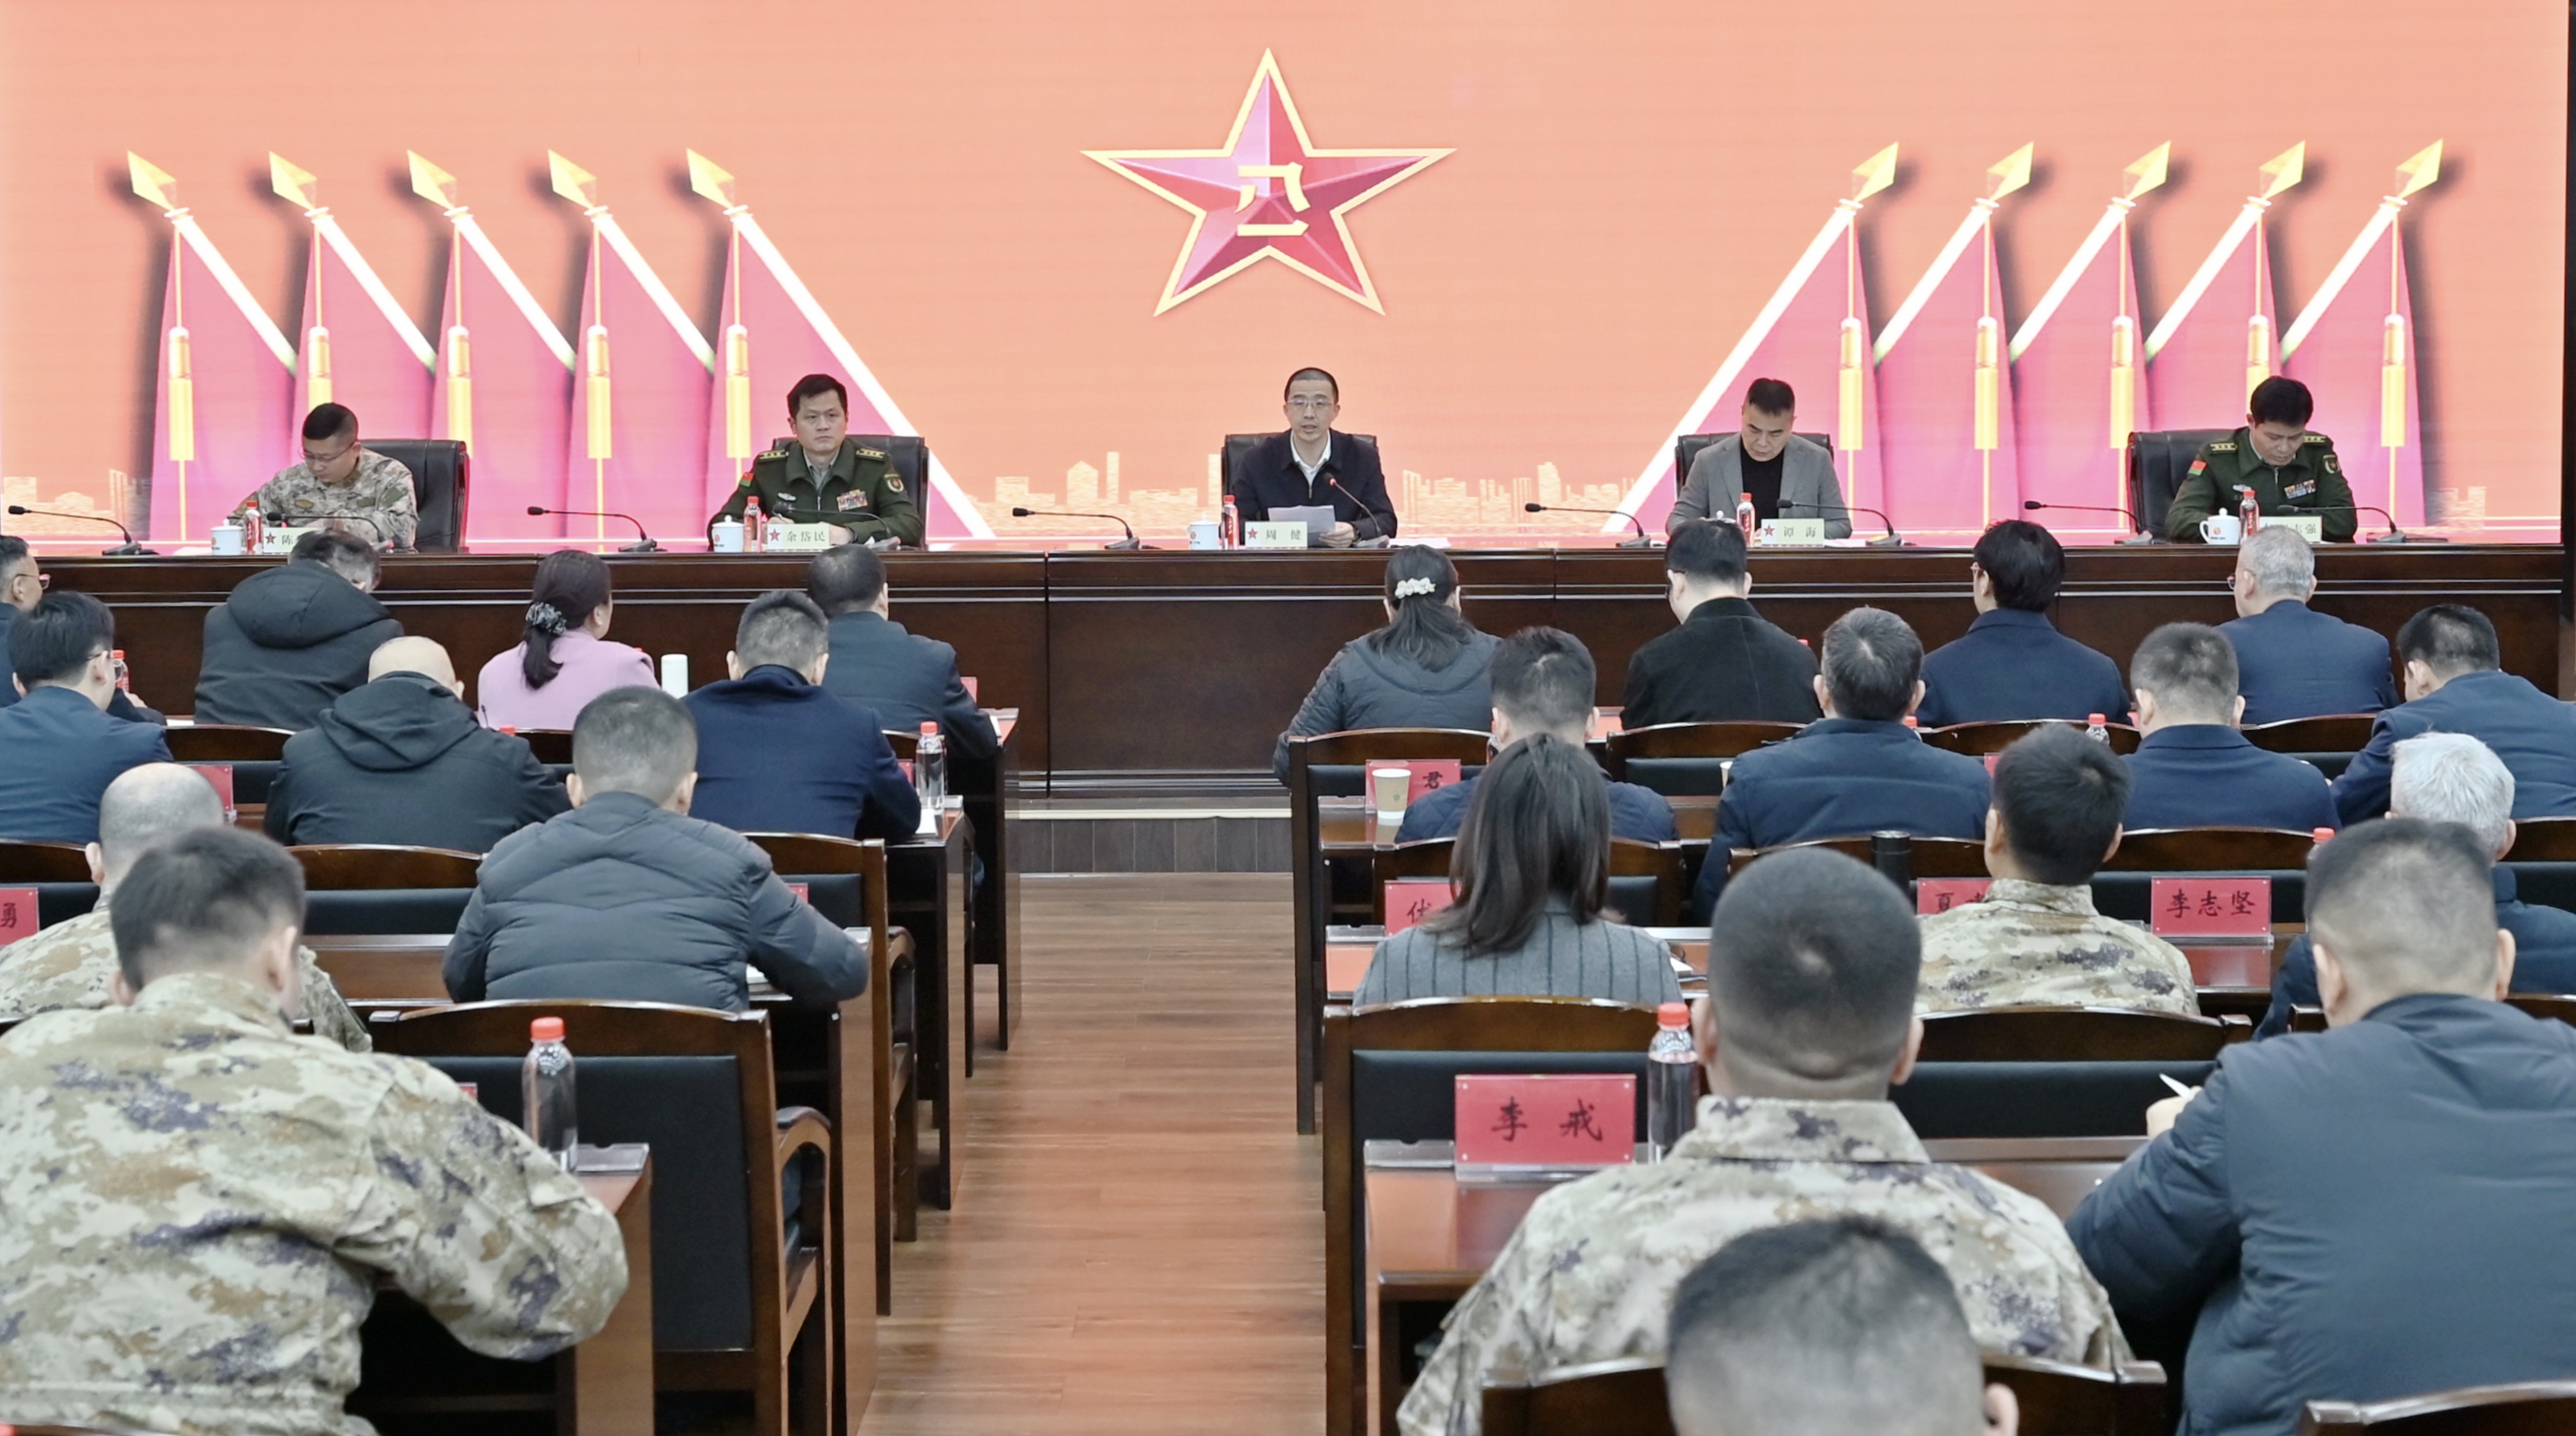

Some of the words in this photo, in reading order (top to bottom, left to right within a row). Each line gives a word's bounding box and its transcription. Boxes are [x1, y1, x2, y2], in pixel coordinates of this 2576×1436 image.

[282, 534, 294, 545] 陈
[1266, 529, 1301, 541] 周健
[1422, 771, 1443, 789] 君
[2167, 888, 2256, 919] 李志坚
[1492, 1095, 1603, 1141] 李戒
